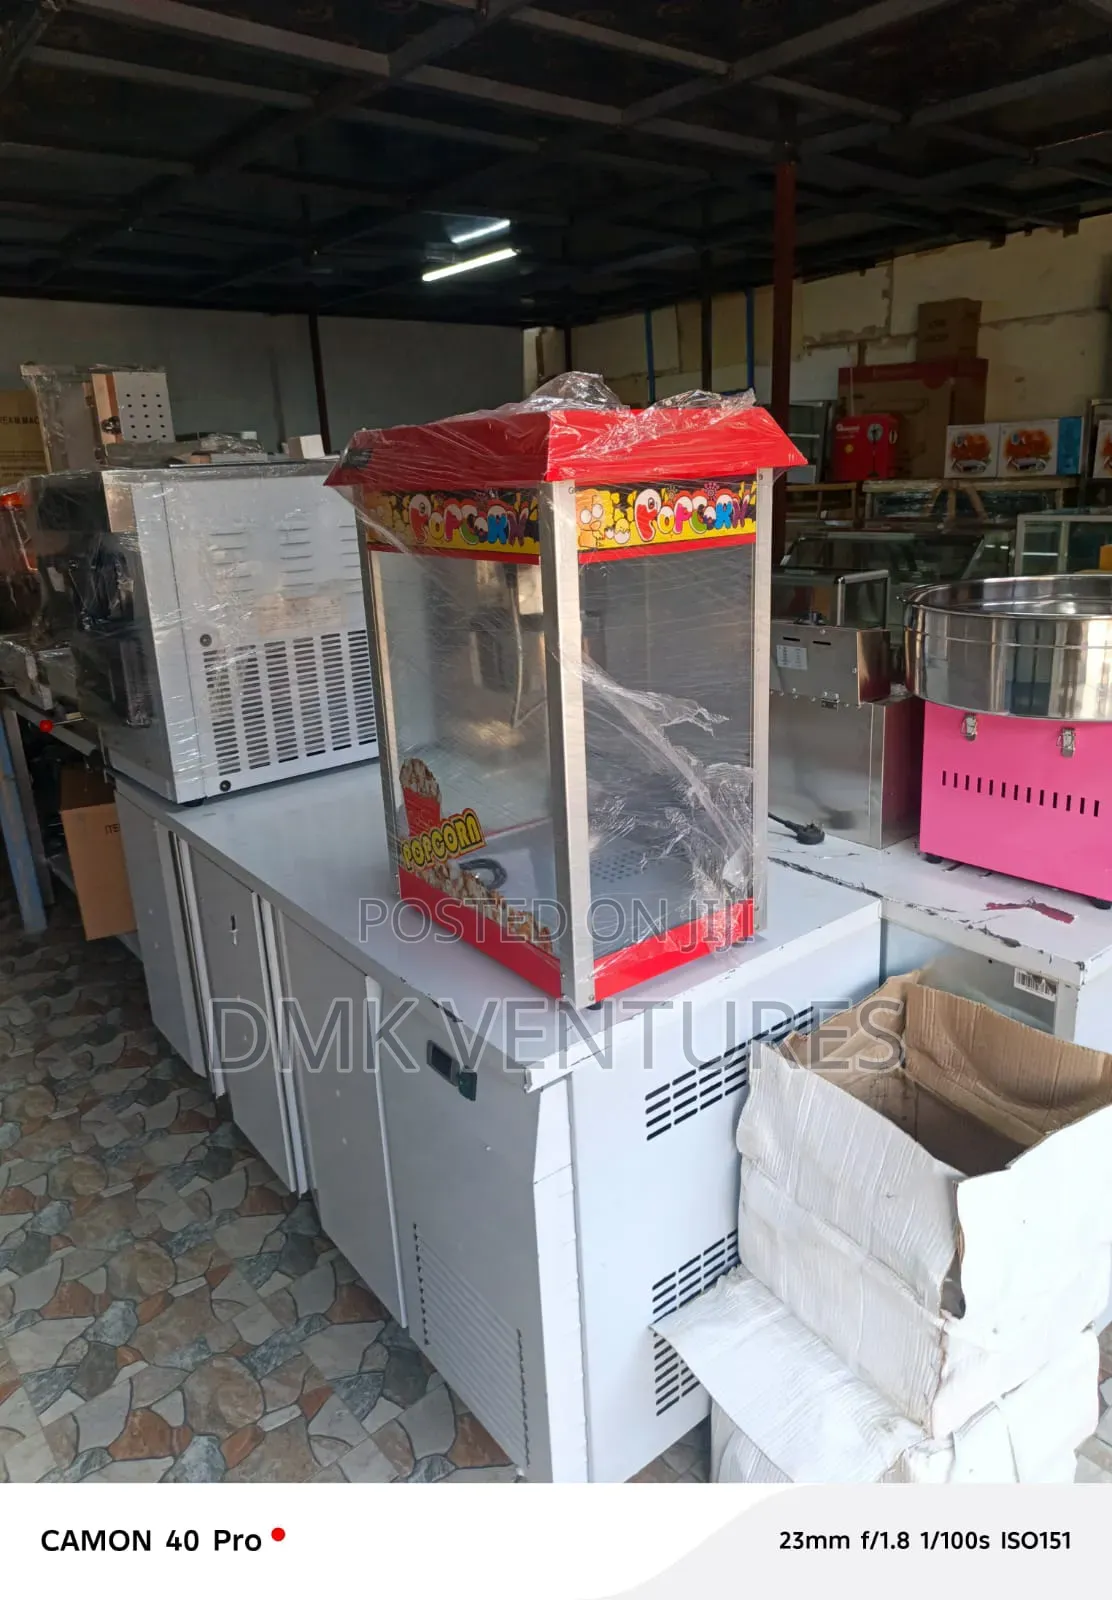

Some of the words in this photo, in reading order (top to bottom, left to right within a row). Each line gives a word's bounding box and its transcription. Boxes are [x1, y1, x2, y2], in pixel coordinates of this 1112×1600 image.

[409, 494, 529, 547] POPCORN
[634, 488, 750, 542] POPCORN
[104, 823, 121, 835] ITE
[401, 812, 482, 872] POPCORN
